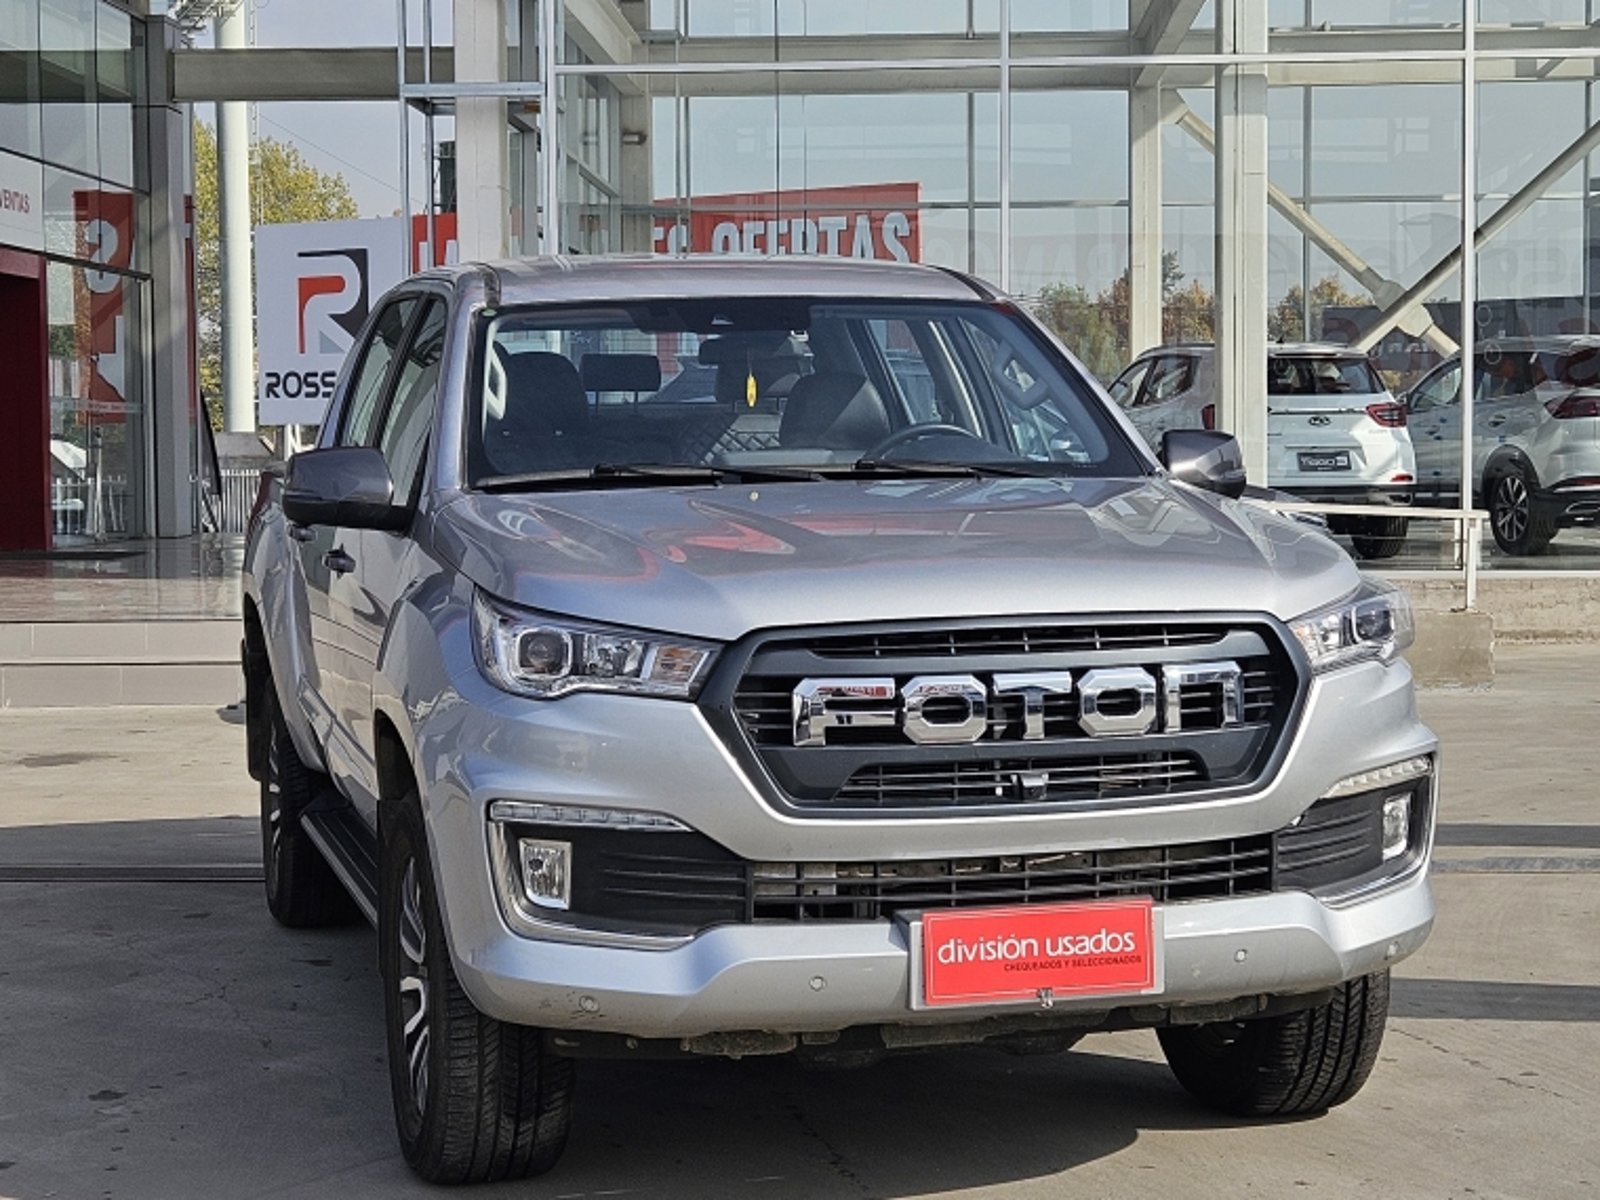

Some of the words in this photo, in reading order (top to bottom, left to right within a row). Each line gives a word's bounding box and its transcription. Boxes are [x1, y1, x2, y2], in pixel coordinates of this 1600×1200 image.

[938, 934, 1038, 964] división
[1046, 928, 1136, 957] usados
[1004, 960, 1063, 972] CHEQUEADOS
[1064, 960, 1071, 968] Y
[1072, 955, 1142, 968] SELECCIONADOS
